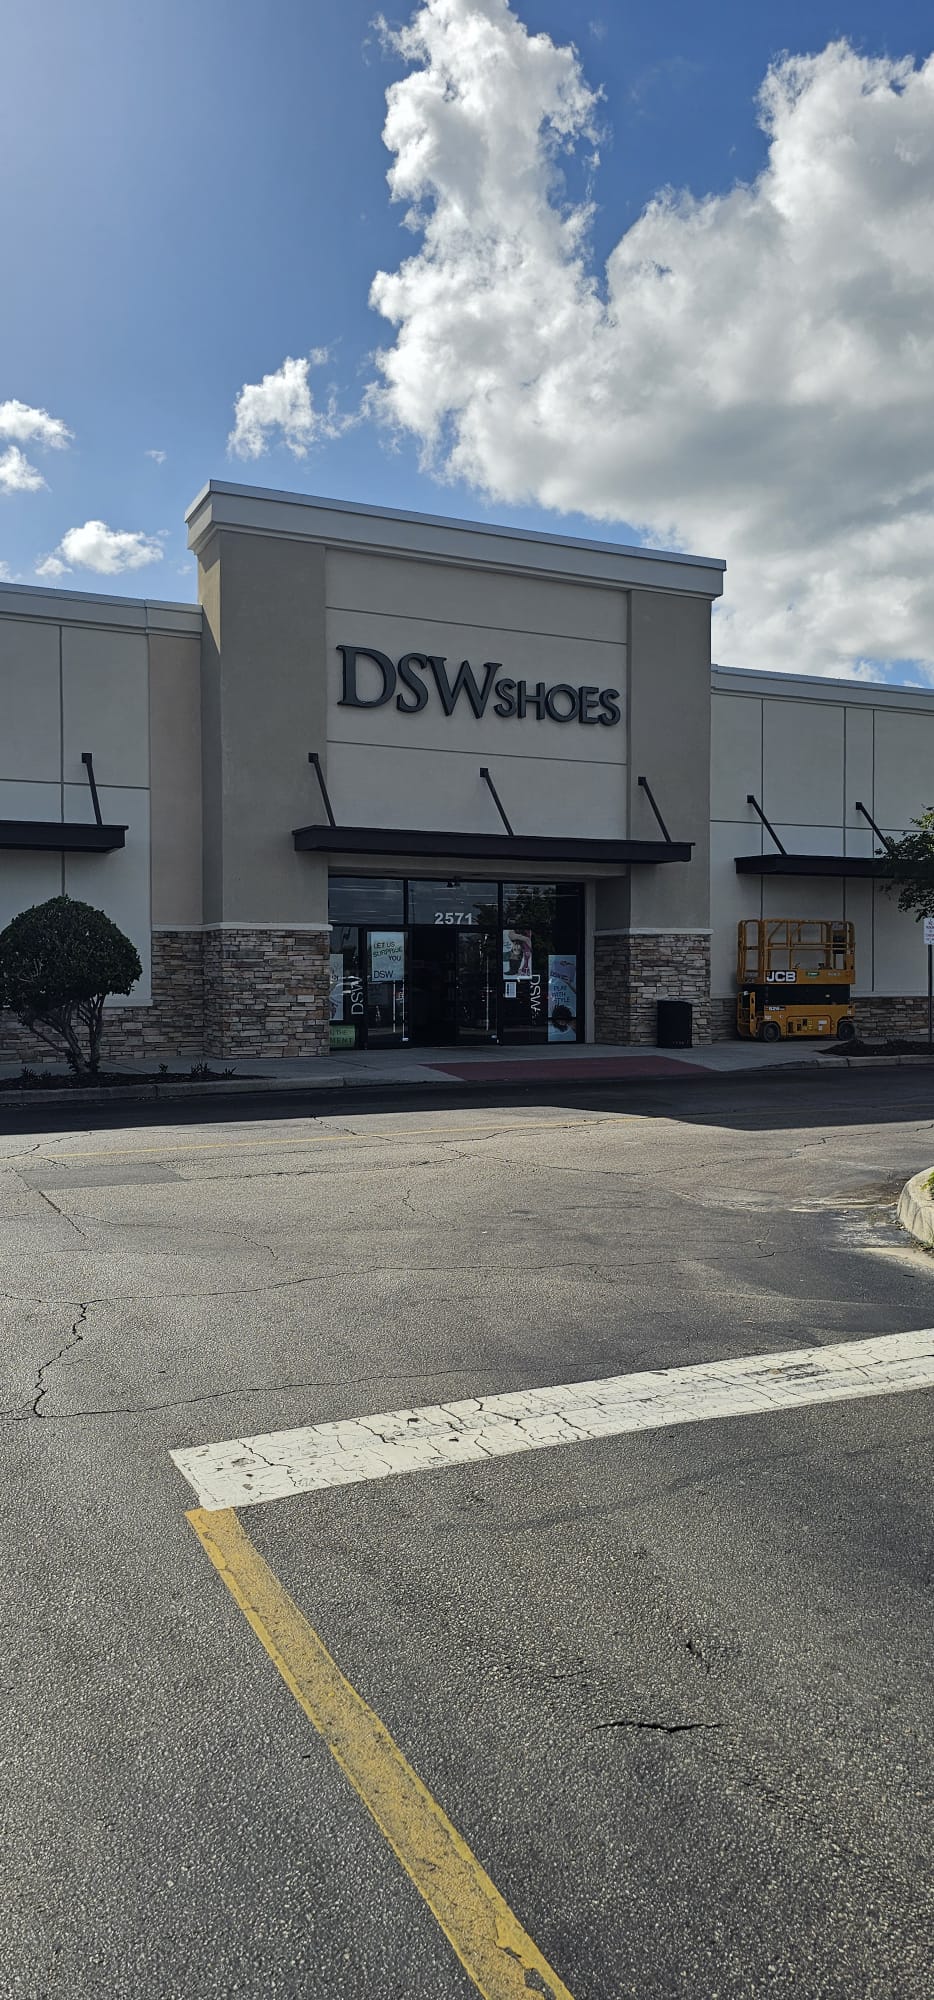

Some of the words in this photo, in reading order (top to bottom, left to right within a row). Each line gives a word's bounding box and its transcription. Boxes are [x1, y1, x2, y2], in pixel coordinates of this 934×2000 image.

[336, 645, 502, 719] DSW
[493, 678, 621, 726] SHOES
[434, 912, 473, 925] 2571
[373, 970, 393, 979] DSW
[766, 971, 796, 982] JCB
[351, 976, 364, 1015] DSW
[530, 974, 541, 1012] DSW
